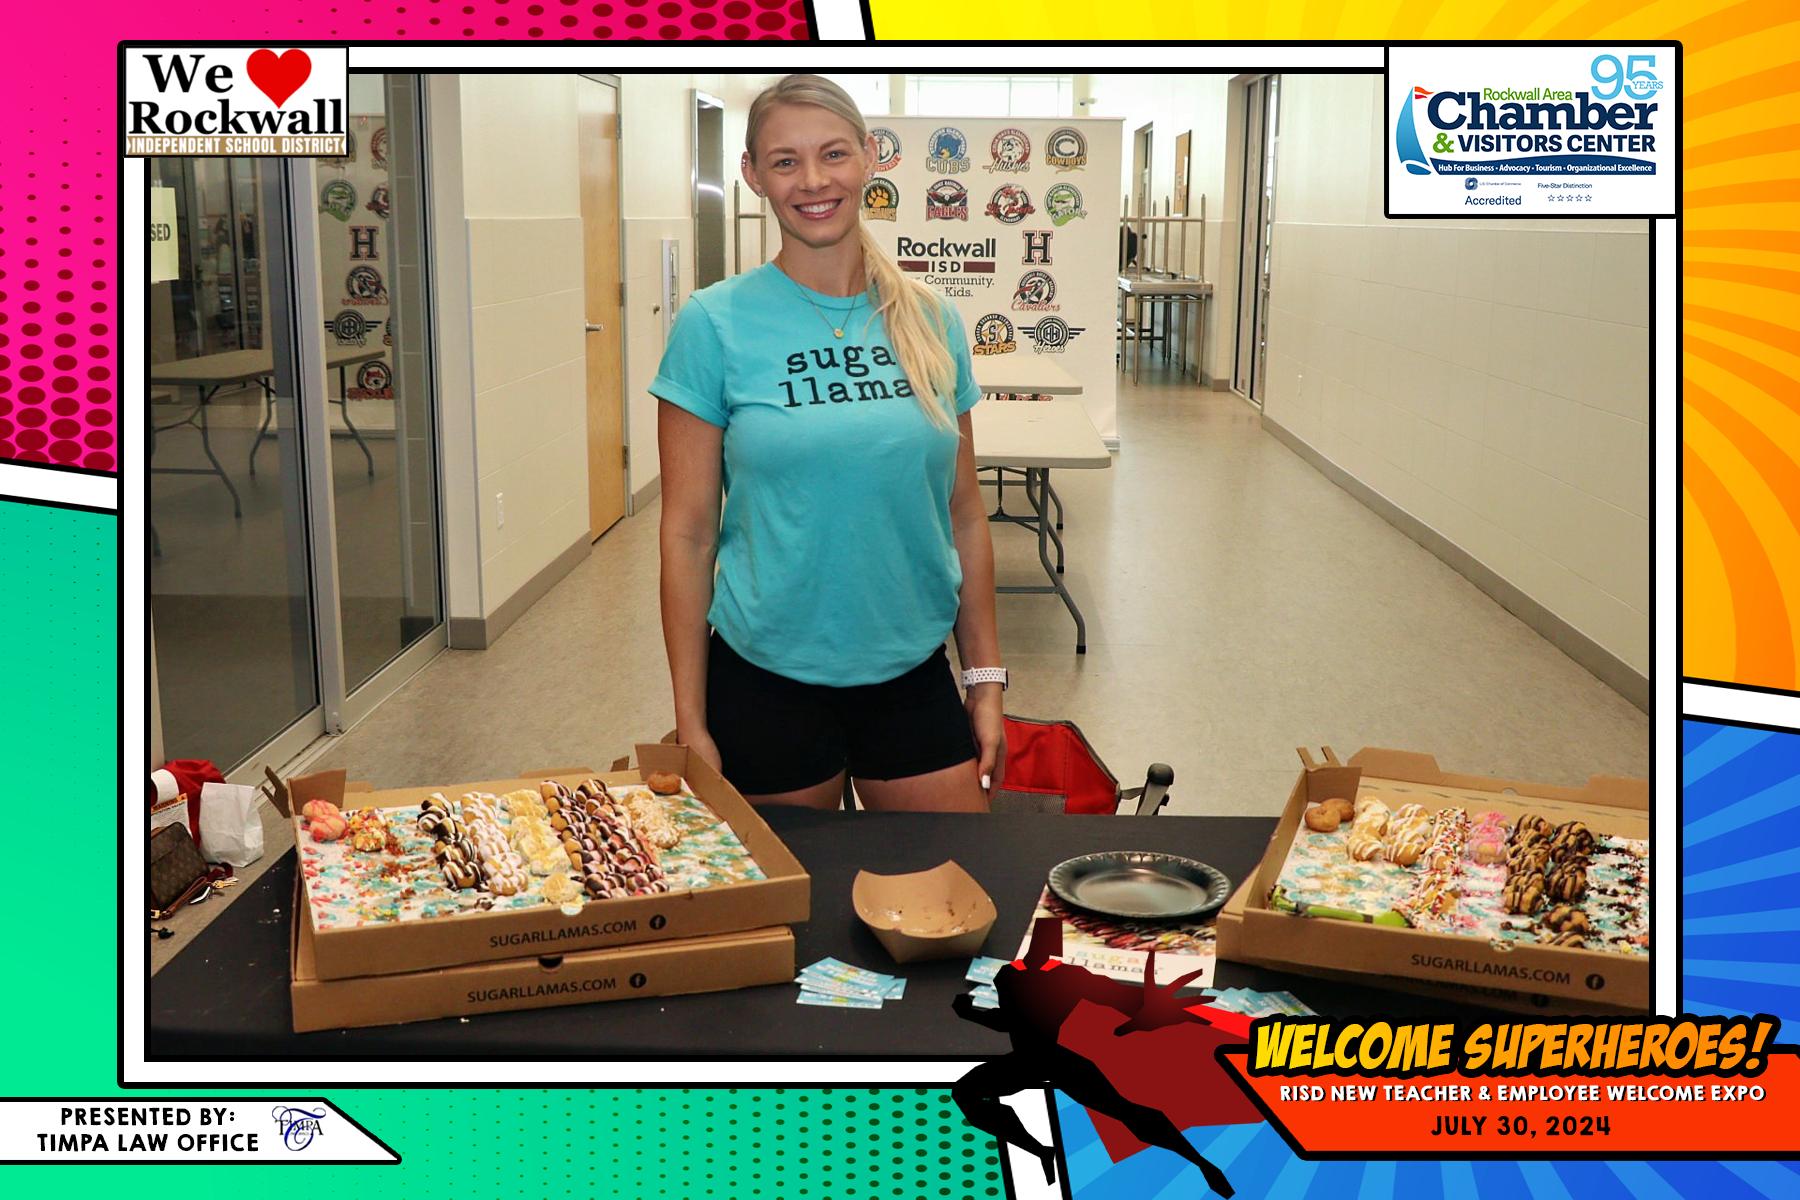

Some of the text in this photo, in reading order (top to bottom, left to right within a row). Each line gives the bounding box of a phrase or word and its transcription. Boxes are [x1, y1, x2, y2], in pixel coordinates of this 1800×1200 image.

[926, 157, 970, 174] CUBS
[897, 237, 996, 257] Rockwall
[1022, 230, 1053, 265] H
[931, 261, 961, 273] ISD
[924, 275, 995, 288] Community.
[945, 286, 973, 297] Kids.
[1011, 299, 1060, 311] Cavaliers
[973, 341, 1016, 355] STARS
[787, 345, 897, 377] suga
[778, 376, 937, 407] llama
[489, 919, 637, 948] SUGARLLAMAS.COM
[1076, 951, 1139, 965] suga
[1411, 953, 1571, 985] SUGARLLAMAS.COM
[467, 976, 617, 1003] SUGARLLAMAS.COM
